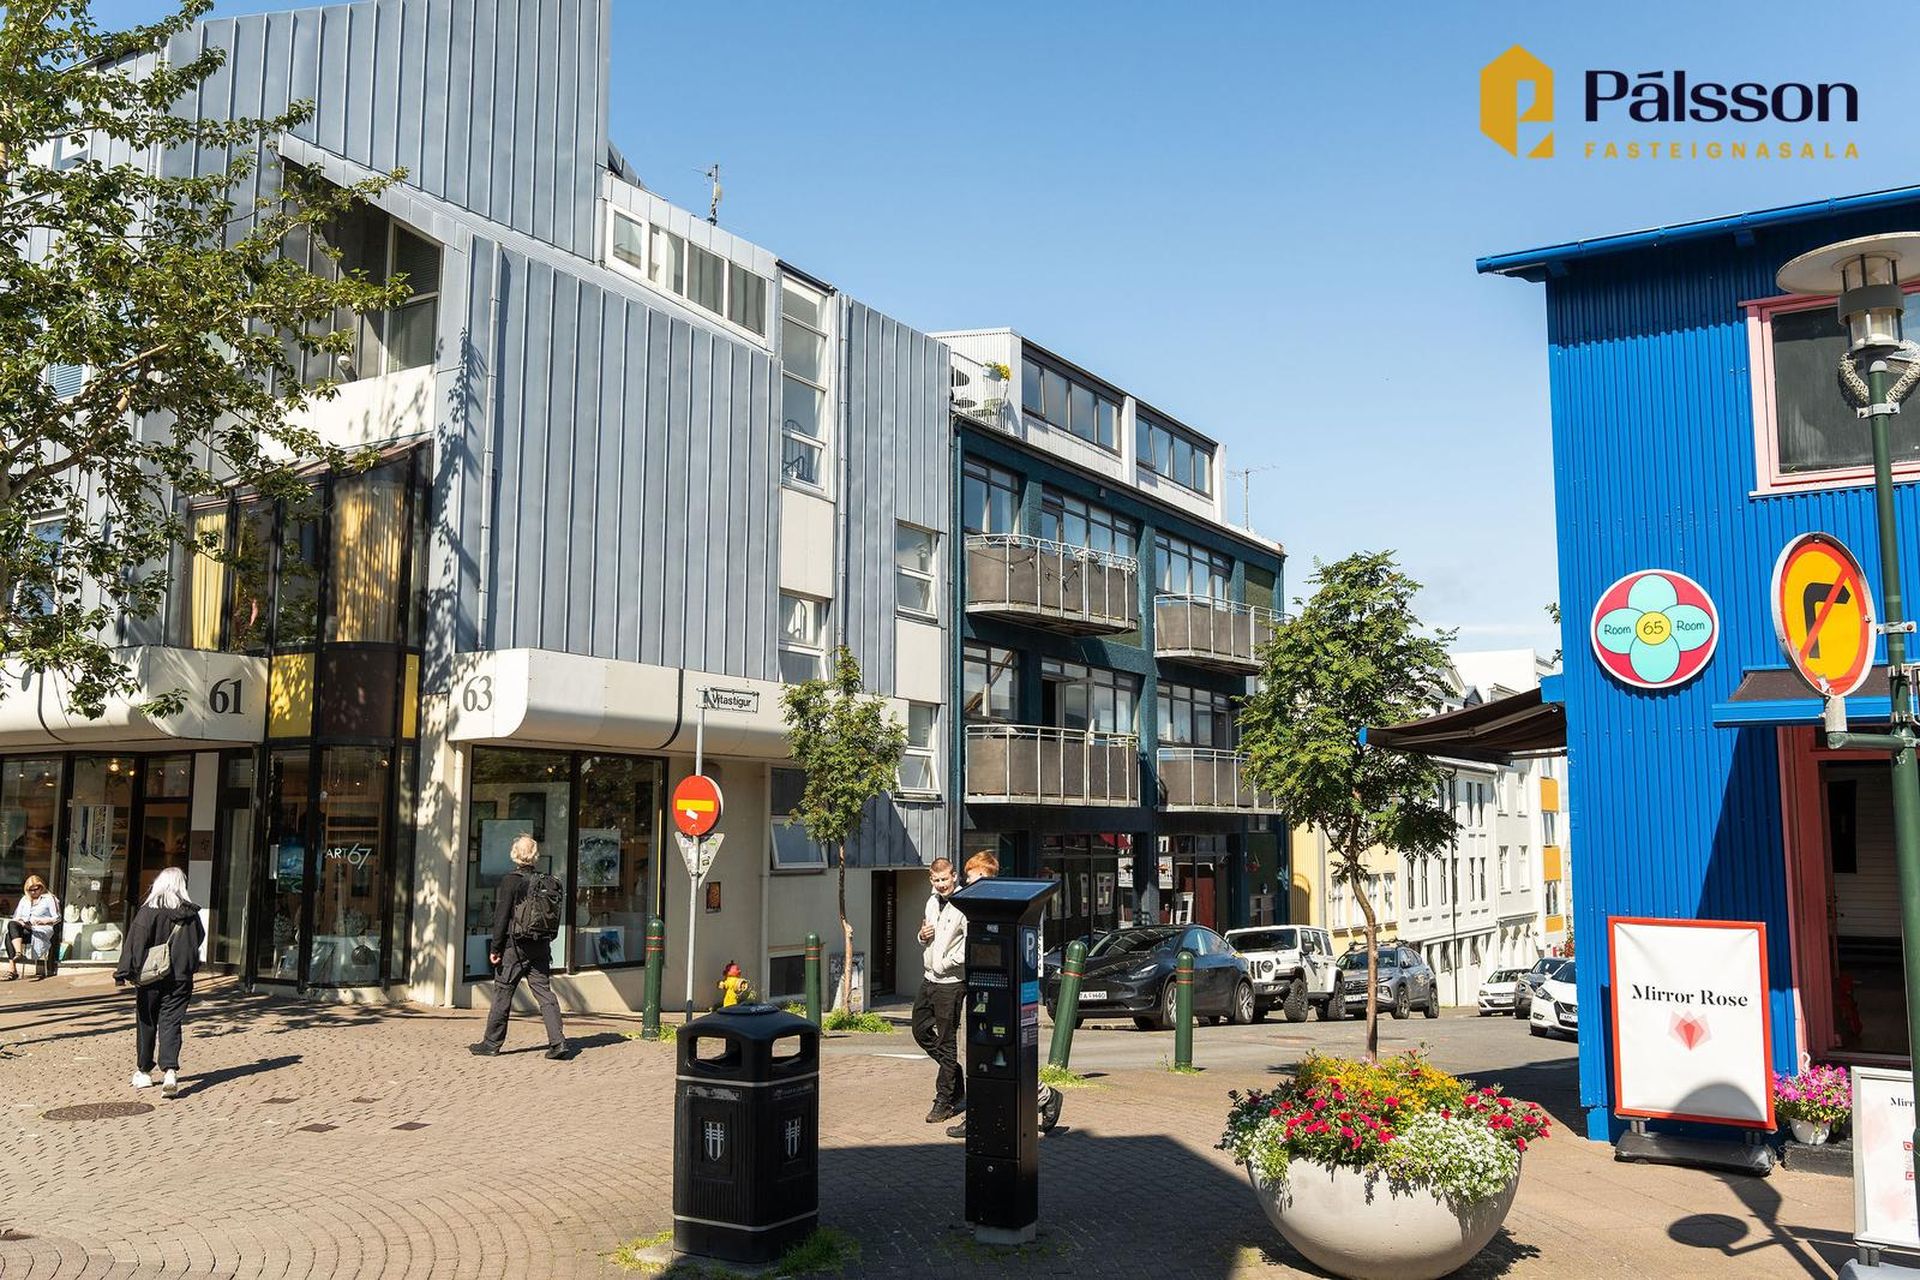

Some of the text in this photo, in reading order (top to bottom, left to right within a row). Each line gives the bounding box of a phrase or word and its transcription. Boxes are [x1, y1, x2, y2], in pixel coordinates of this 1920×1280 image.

[1604, 620, 1705, 635] Room 65 Room
[209, 678, 245, 715] 61
[463, 675, 492, 712] 63
[1632, 984, 1748, 1007] Mirror Rose
